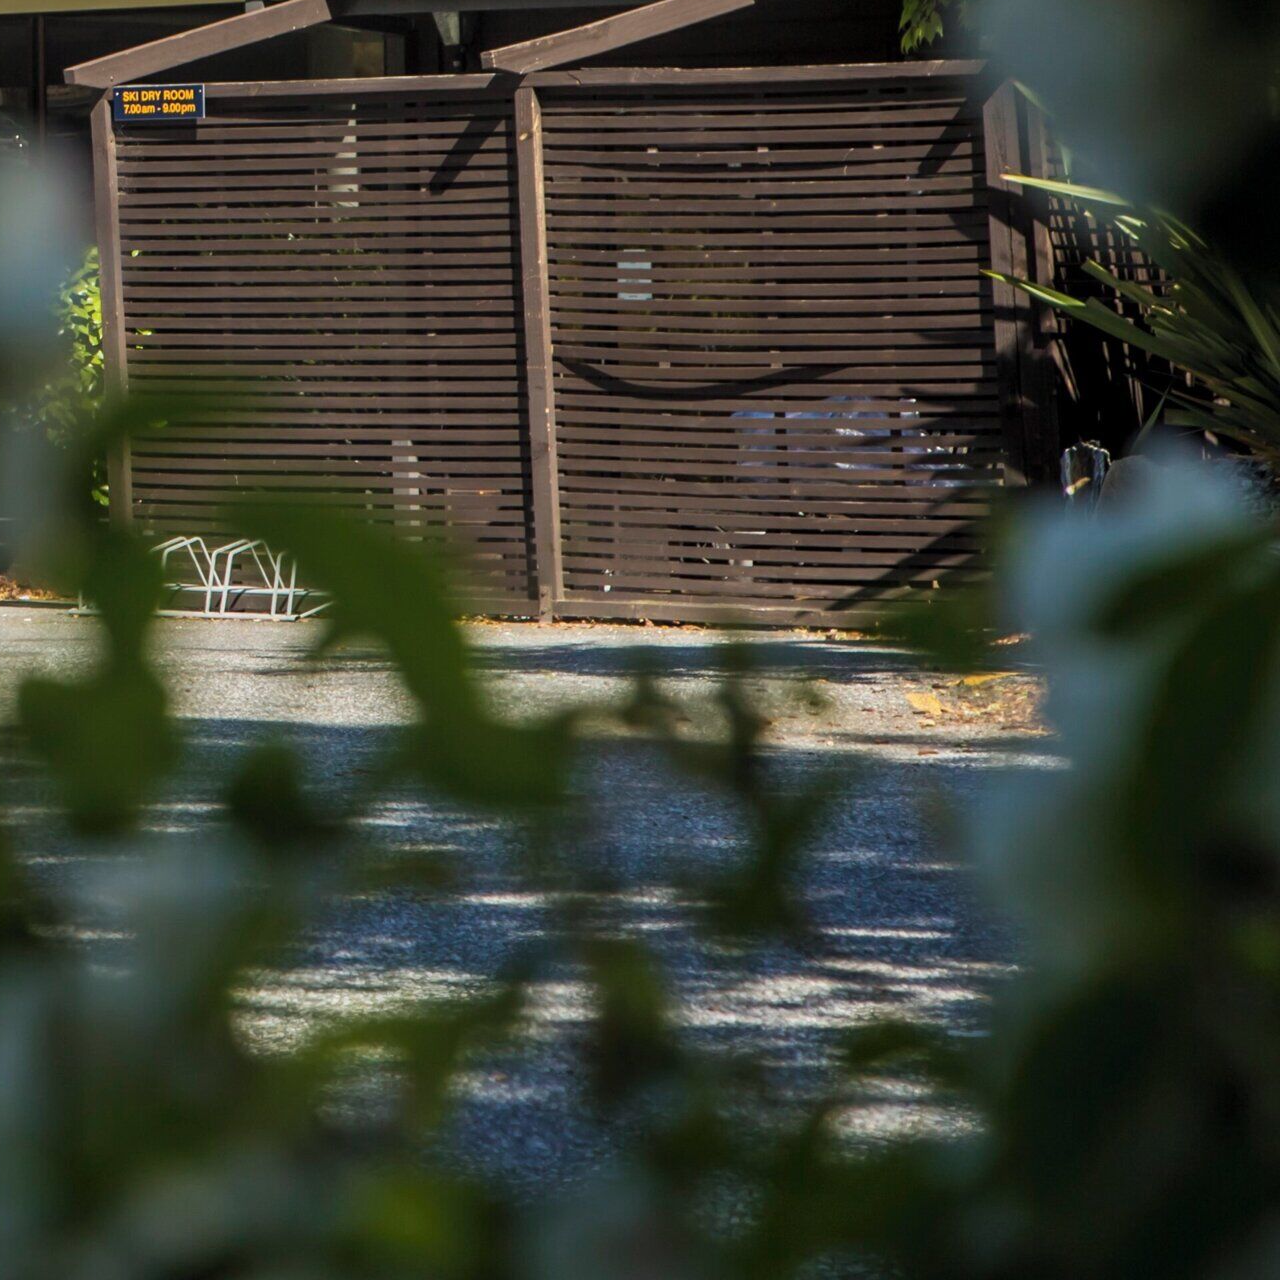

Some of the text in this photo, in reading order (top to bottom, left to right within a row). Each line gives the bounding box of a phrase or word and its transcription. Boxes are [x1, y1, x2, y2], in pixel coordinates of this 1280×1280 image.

[123, 89, 194, 101] SKI DRY ROOM
